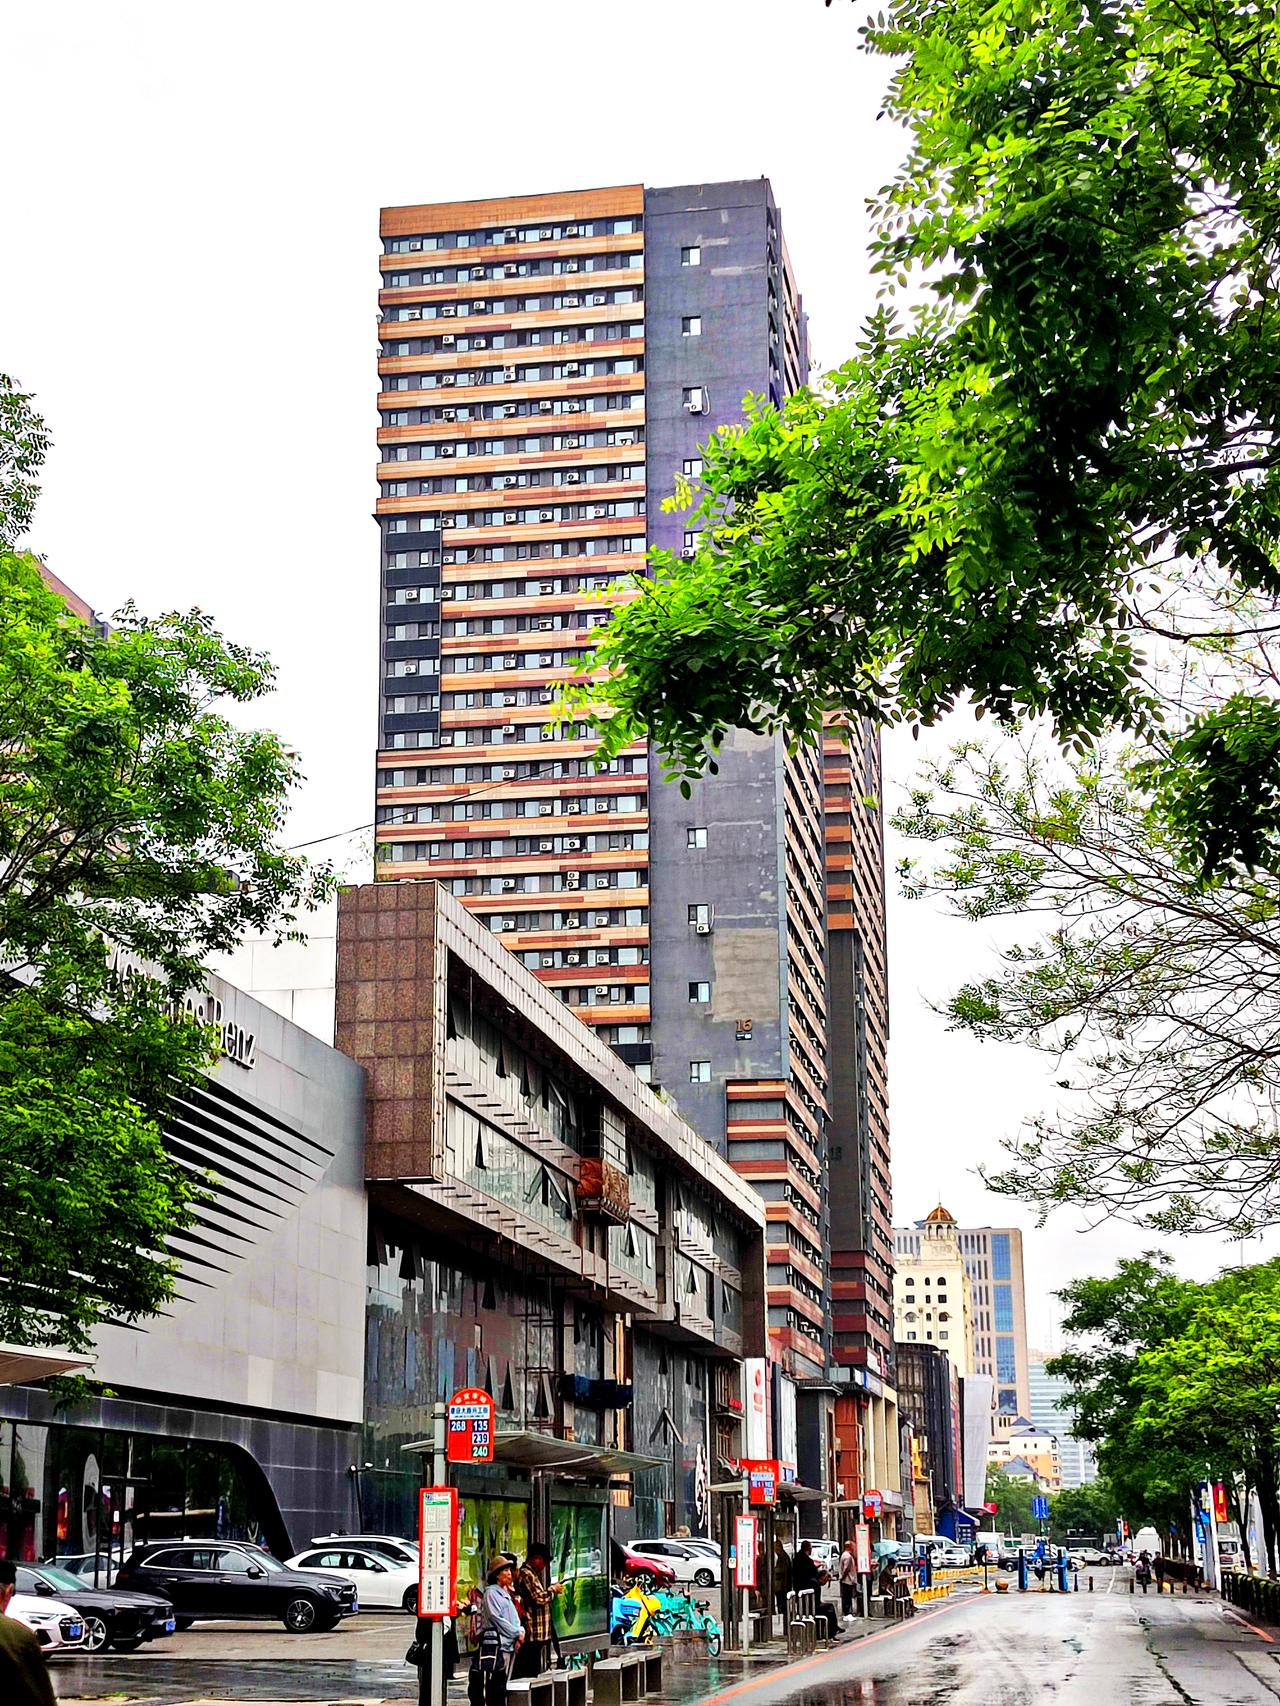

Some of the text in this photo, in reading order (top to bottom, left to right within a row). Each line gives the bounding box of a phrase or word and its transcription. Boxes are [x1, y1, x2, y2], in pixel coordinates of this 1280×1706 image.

[451, 1420, 488, 1432] 268 135
[473, 1433, 488, 1444] 239
[472, 1446, 488, 1457] 240
